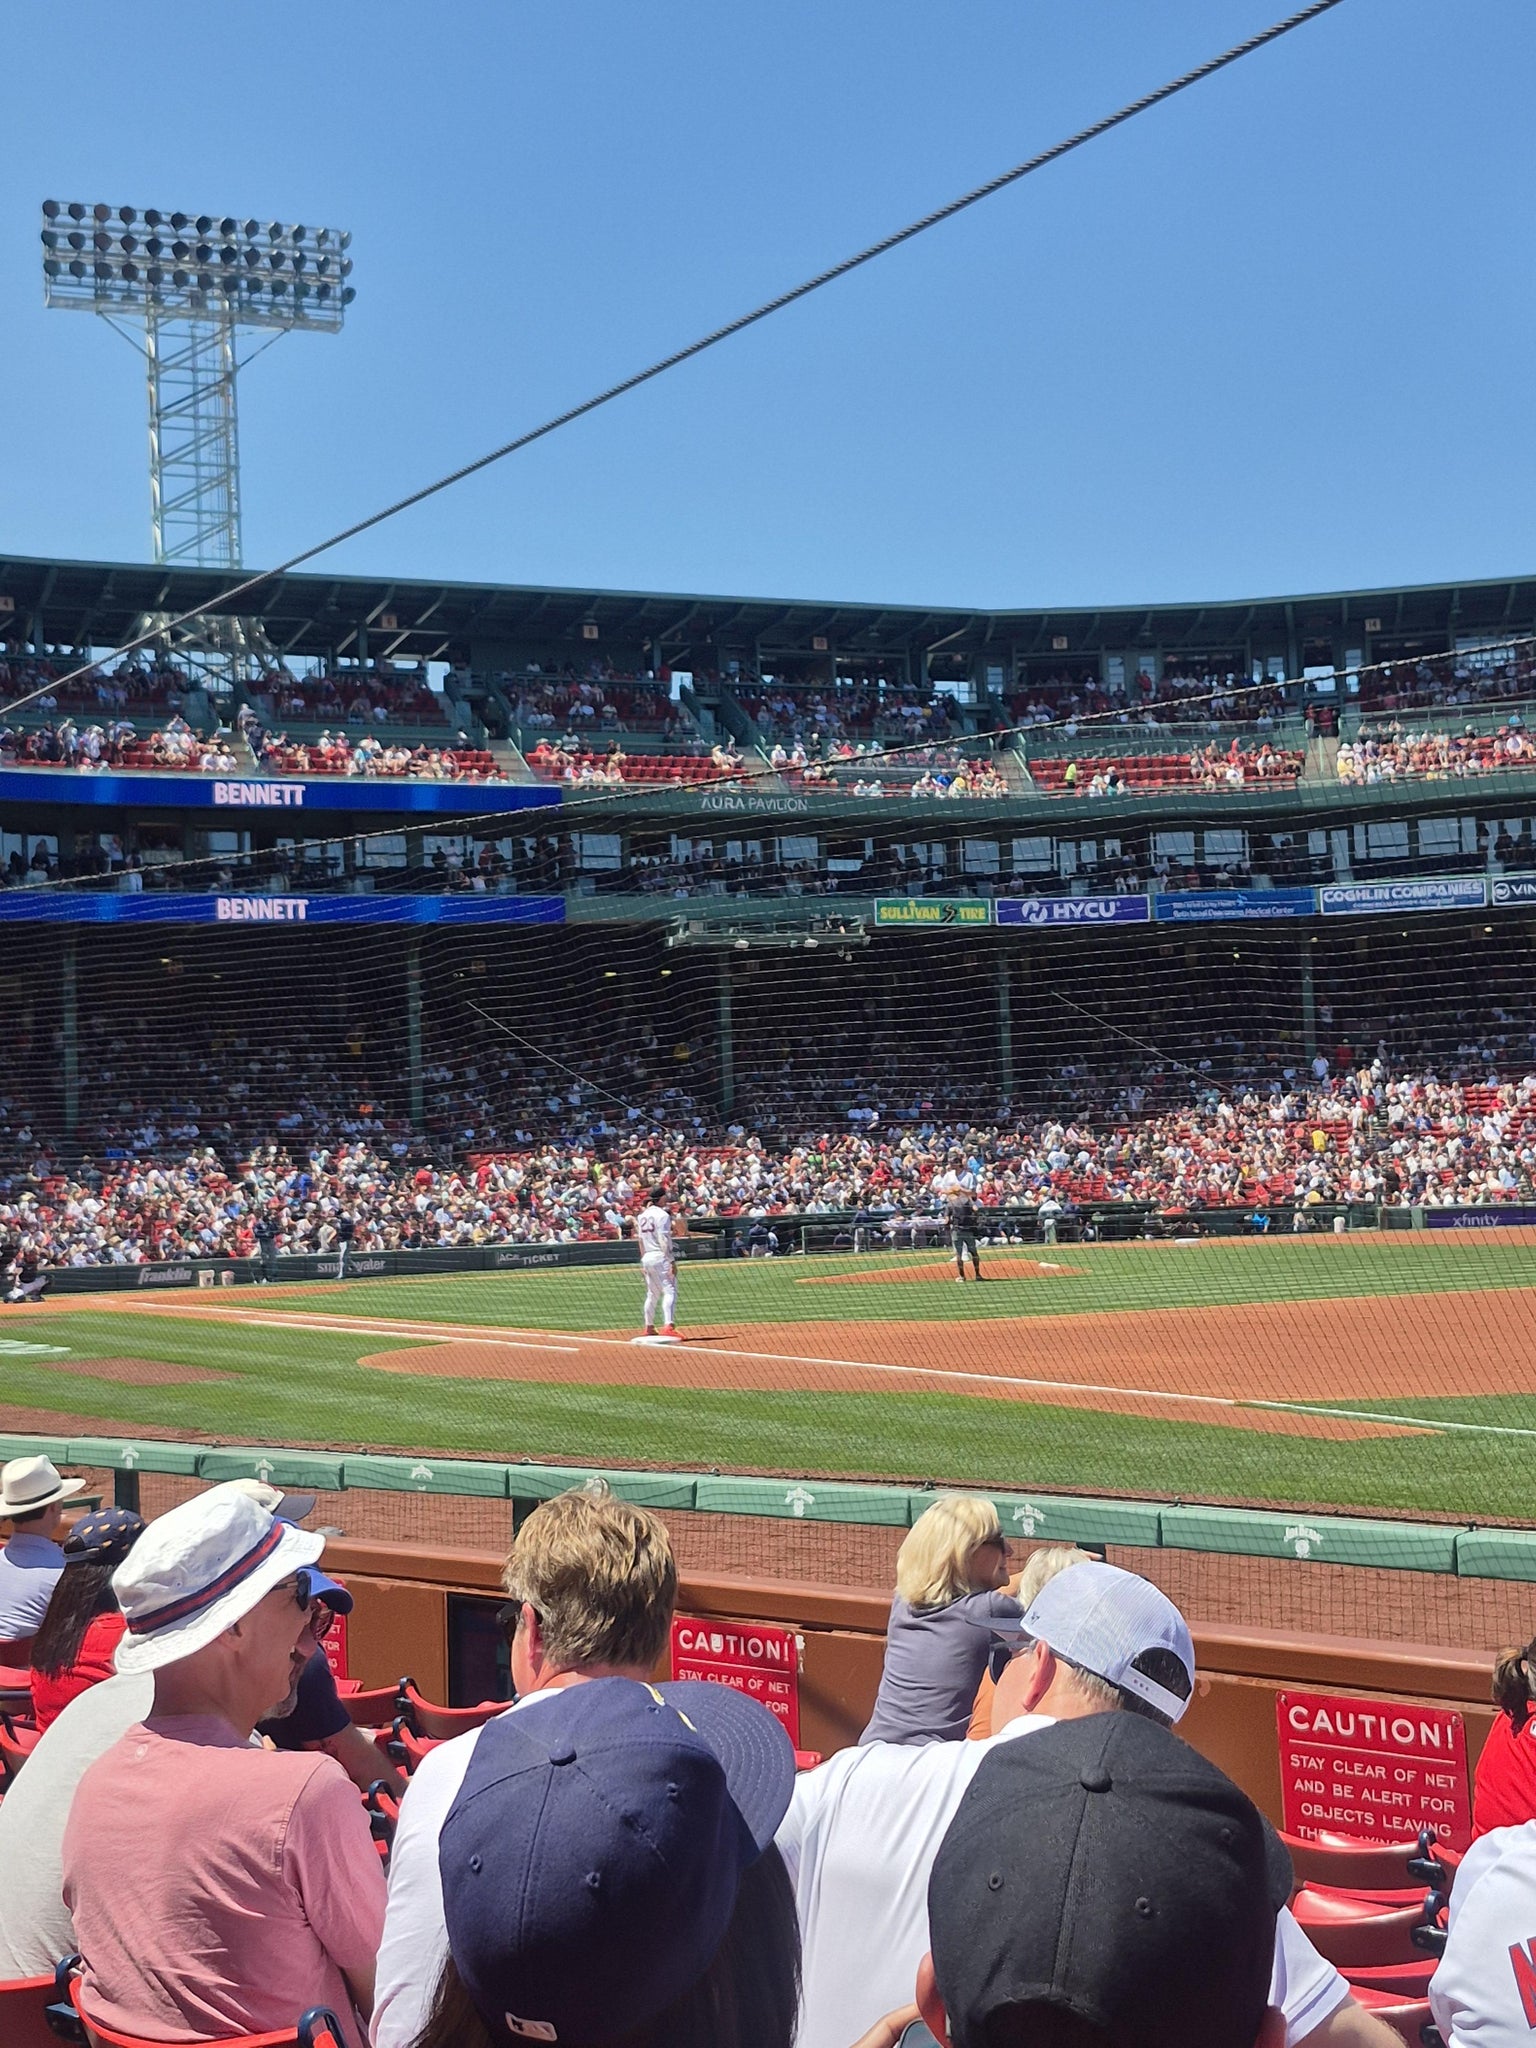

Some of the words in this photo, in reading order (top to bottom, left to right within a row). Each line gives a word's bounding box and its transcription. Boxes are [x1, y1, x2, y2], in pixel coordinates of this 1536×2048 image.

[214, 782, 306, 805] BENNETT
[748, 797, 807, 811] PAVILION
[1323, 887, 1390, 903] COGHLIN
[1391, 881, 1483, 899] COMPANIES
[217, 898, 309, 920] BENNETT
[880, 900, 940, 920] SULLIVAN
[961, 907, 986, 920] TIRE
[1053, 901, 1117, 919] HYCU
[1453, 1213, 1499, 1227] xfinity
[521, 1253, 560, 1266] TICKET
[329, 1624, 341, 1634] ET
[679, 1629, 790, 1661] CAUTION!
[679, 1669, 704, 1681] STAY
[707, 1672, 744, 1688] CLEAR
[748, 1678, 764, 1690] OF
[768, 1682, 790, 1694] NET
[765, 1700, 790, 1714] FOR
[1288, 1705, 1454, 1749] CAUTION!
[1290, 1754, 1326, 1770] STAY
[1332, 1760, 1387, 1779] CLEAR
[1394, 1768, 1417, 1783] OF
[1425, 1773, 1457, 1789] NET
[1294, 1778, 1325, 1794] AND
[1333, 1784, 1355, 1798] BE
[1361, 1788, 1413, 1807] ALERT
[1420, 1797, 1456, 1813] FOR
[1301, 1803, 1376, 1825] OBJECTS
[1383, 1815, 1452, 1837] LEAVING
